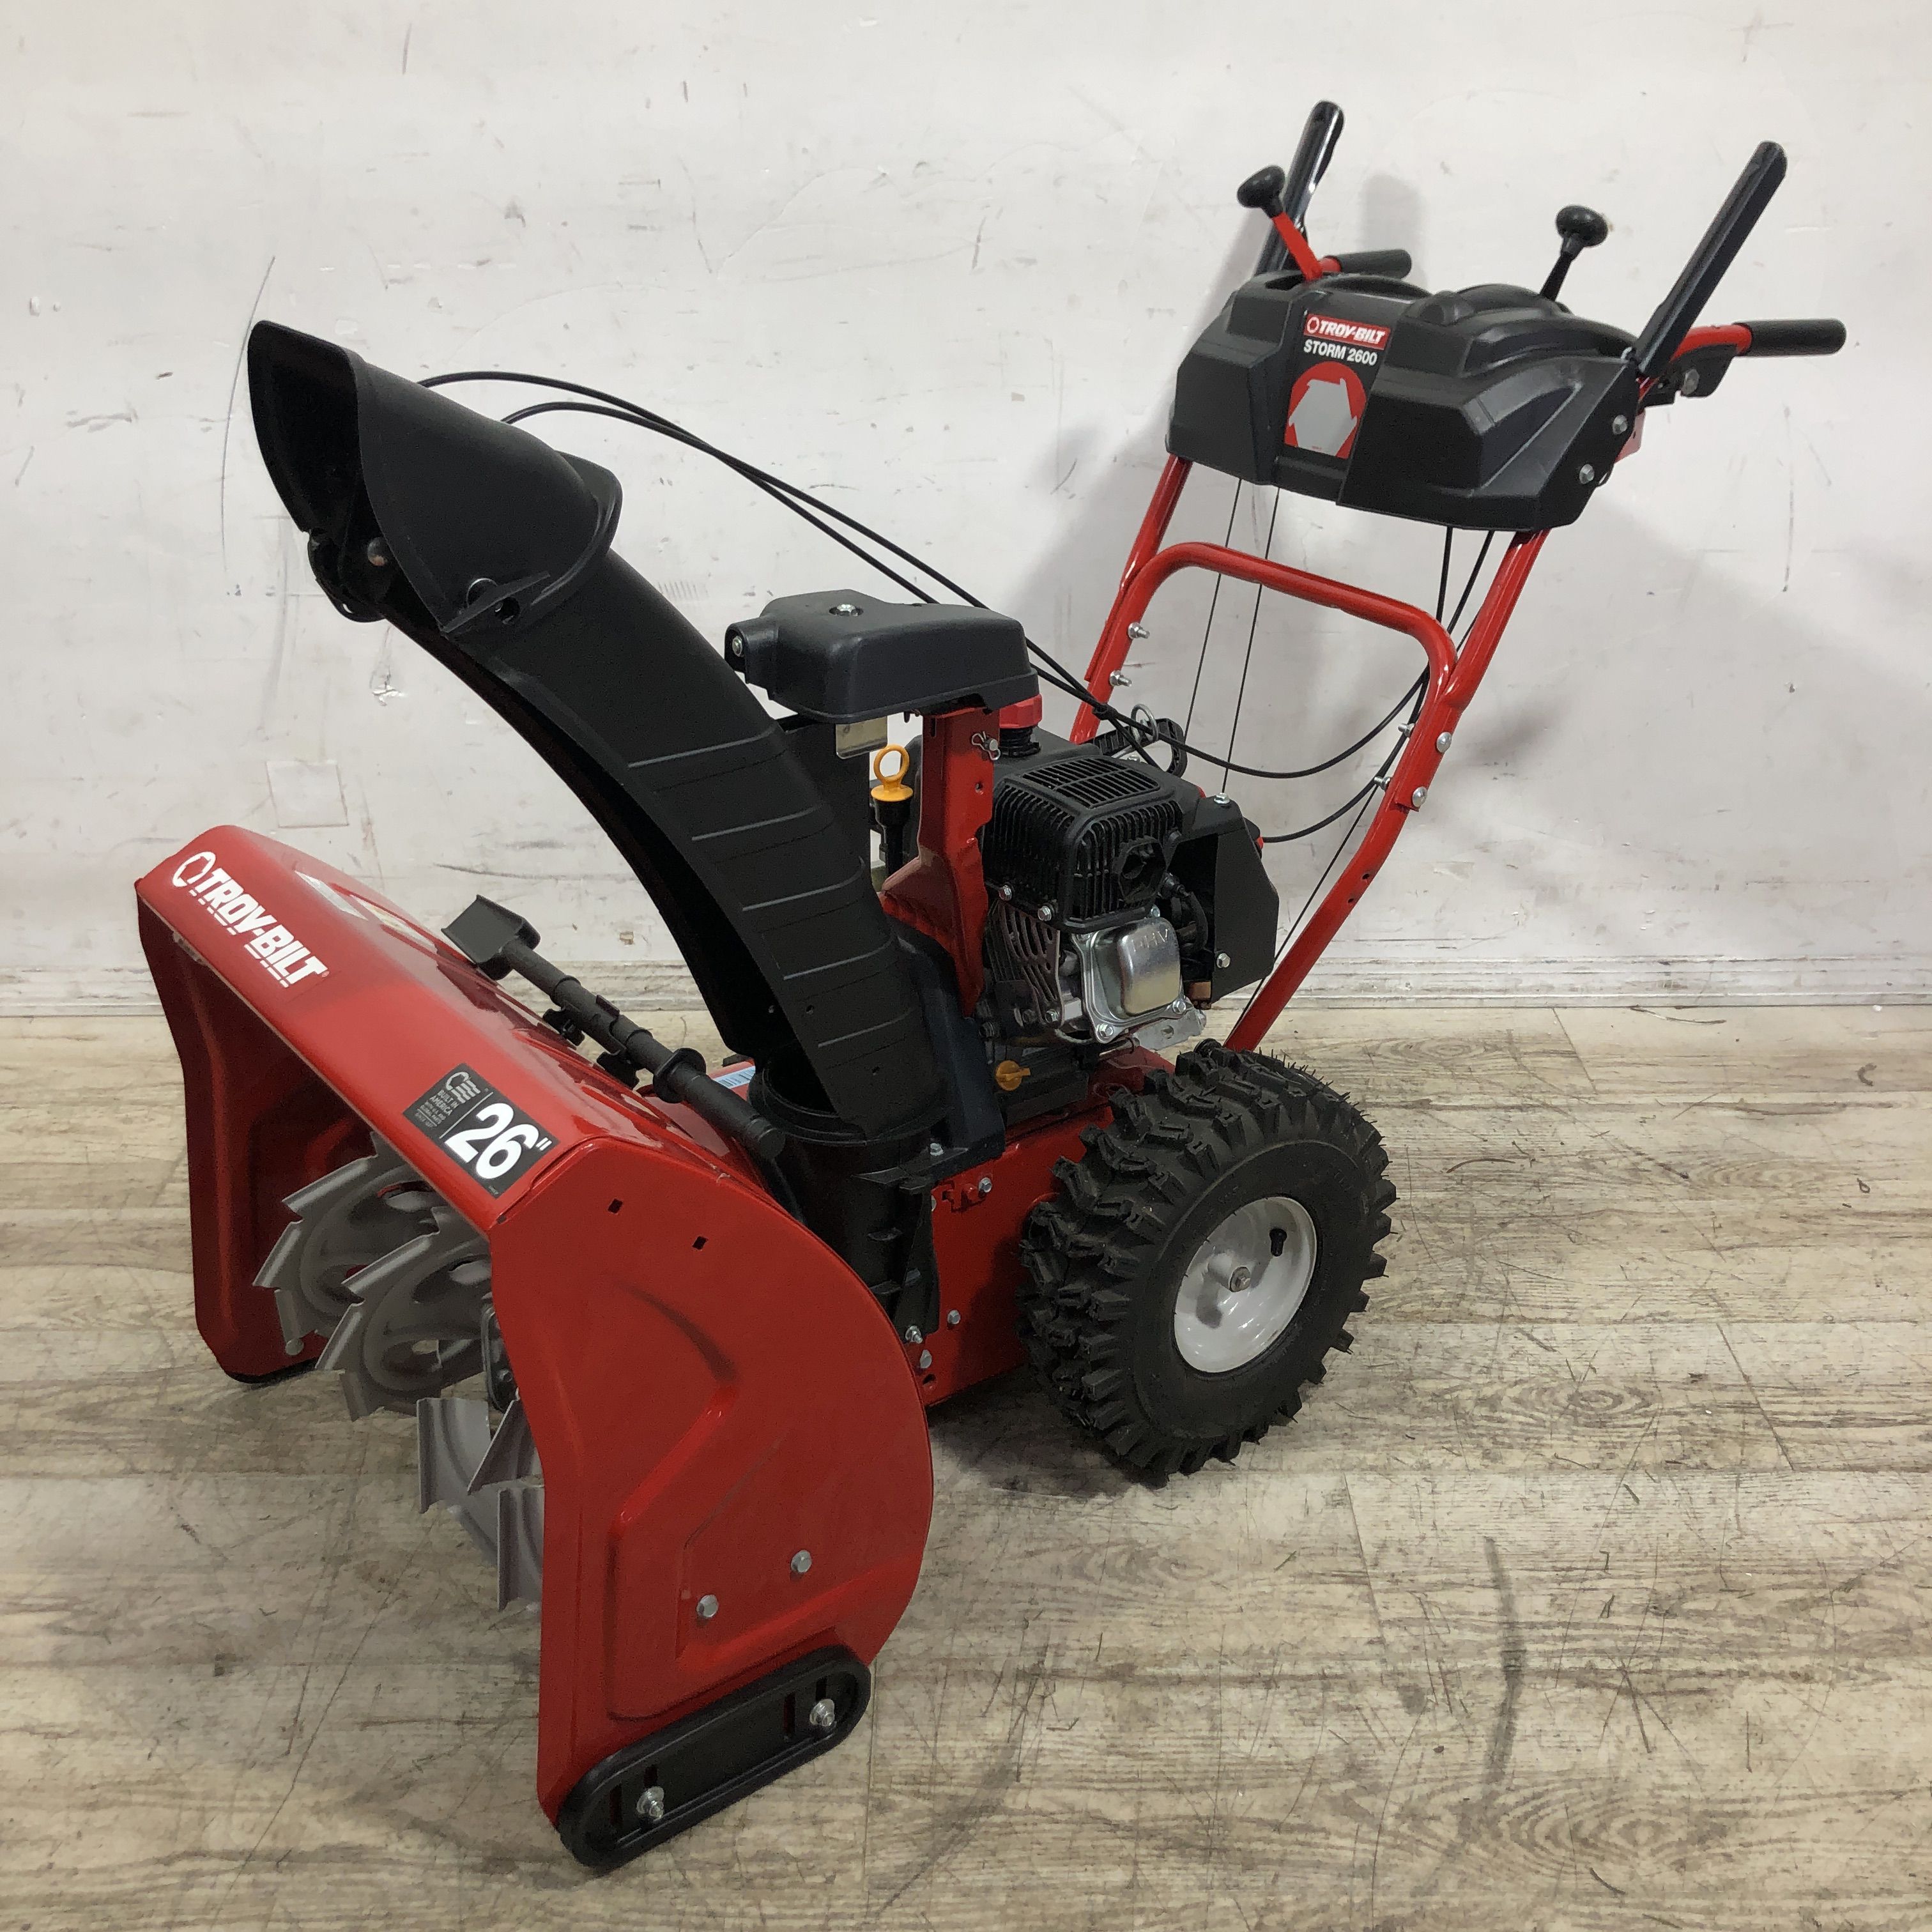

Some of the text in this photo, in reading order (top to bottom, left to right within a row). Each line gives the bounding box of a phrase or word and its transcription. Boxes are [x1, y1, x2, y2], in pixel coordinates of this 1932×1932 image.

[1318, 320, 1385, 344] TROY-BILT
[1303, 339, 1378, 366] STORM 2600
[188, 867, 328, 988] TROY-BILT
[428, 1094, 454, 1116] AMERICA
[436, 1089, 454, 1103] BUILT
[450, 1100, 459, 1108] IN
